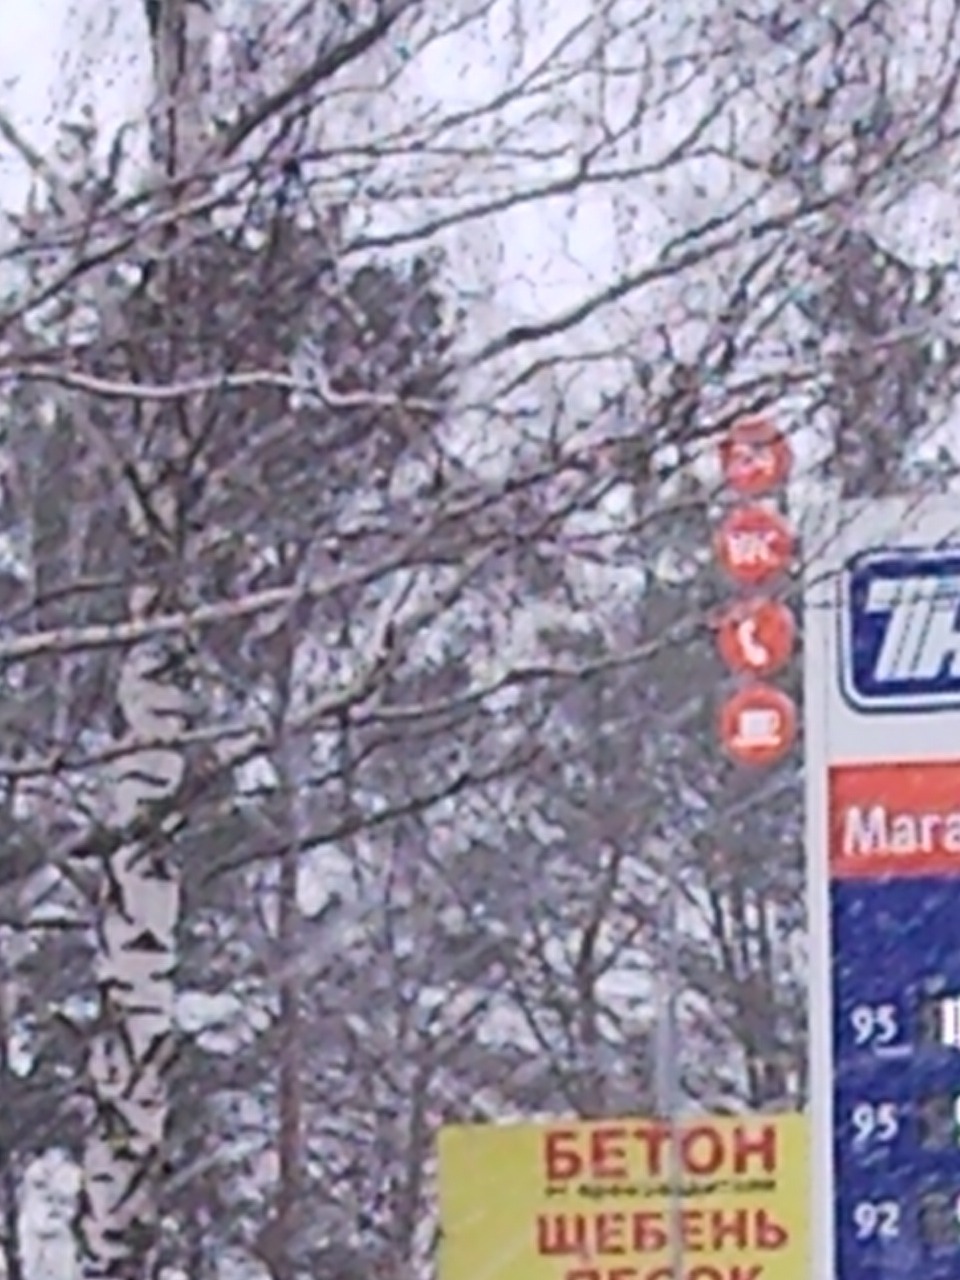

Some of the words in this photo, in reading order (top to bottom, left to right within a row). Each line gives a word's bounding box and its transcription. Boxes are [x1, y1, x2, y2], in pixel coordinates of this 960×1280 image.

[851, 1003, 898, 1045] 95
[852, 1103, 898, 1146] 95
[543, 1124, 776, 1180] БЕТОН
[854, 1202, 899, 1240] 92
